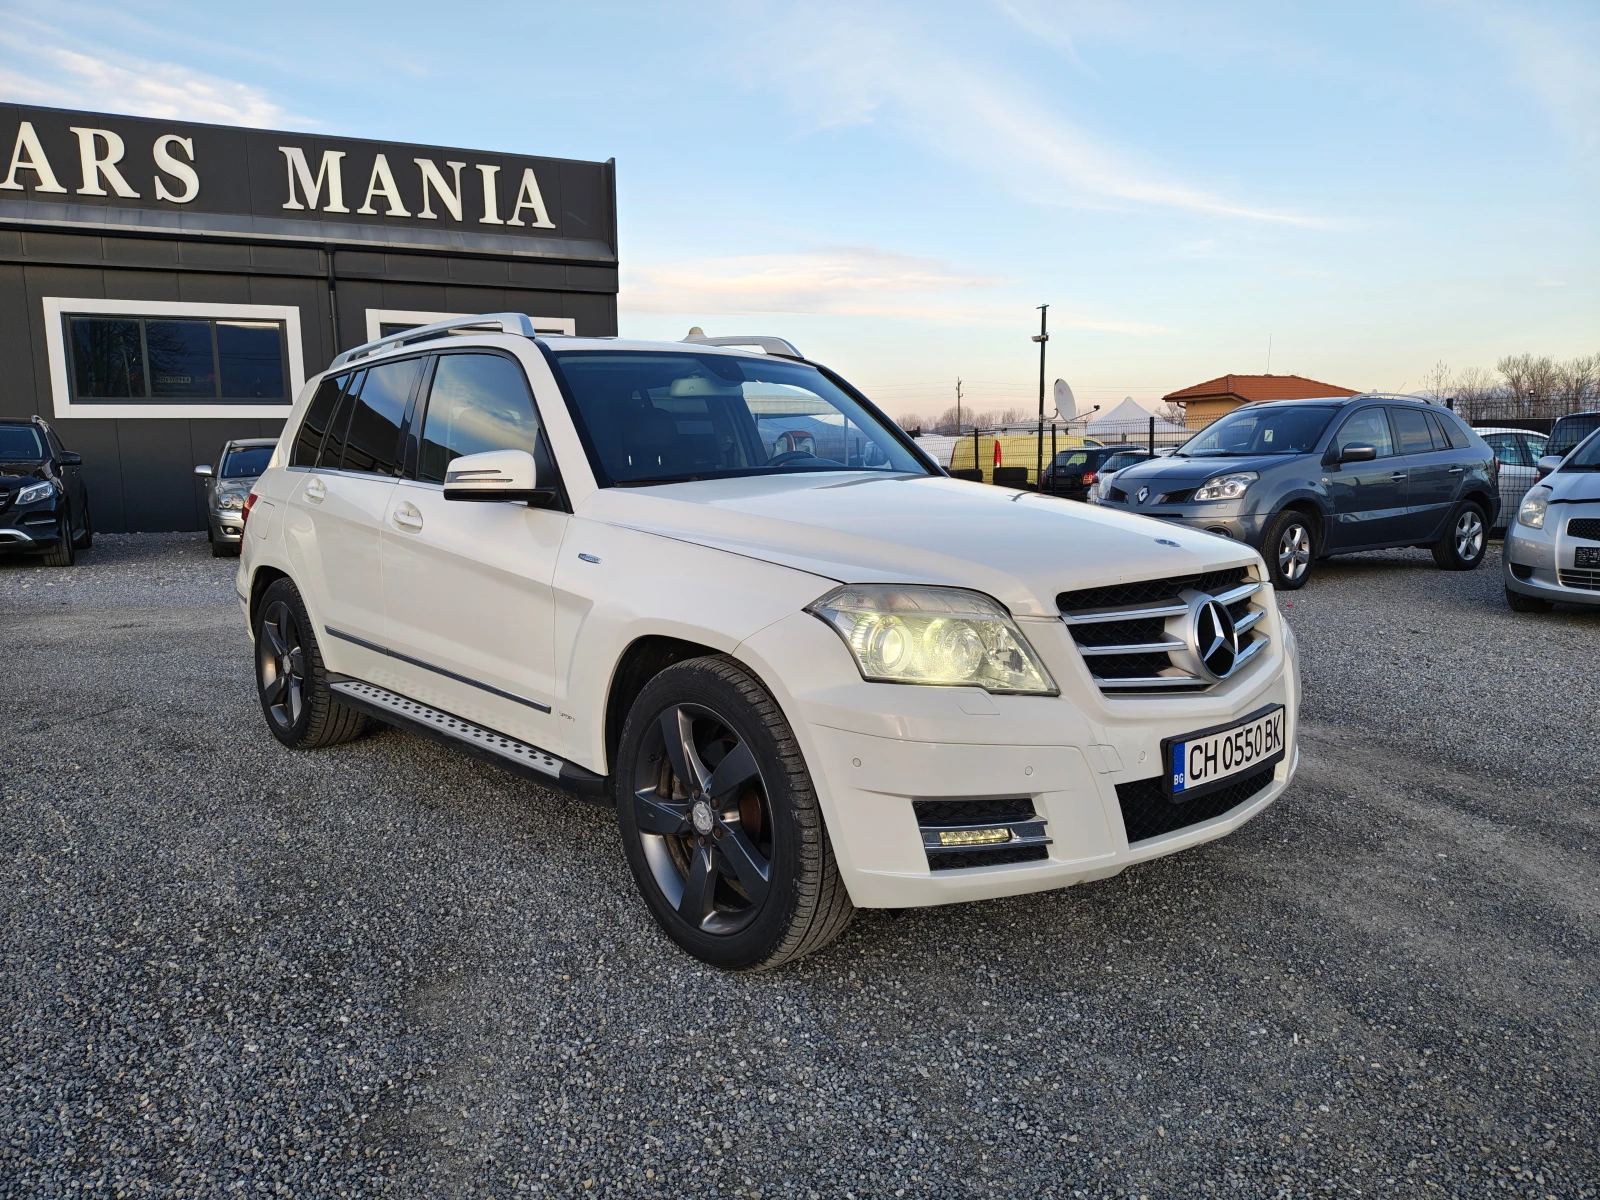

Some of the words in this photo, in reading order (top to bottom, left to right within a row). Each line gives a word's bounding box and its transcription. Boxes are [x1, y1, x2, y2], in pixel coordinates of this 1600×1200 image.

[0, 121, 200, 204] ARS
[278, 146, 556, 230] MANIA
[1173, 773, 1184, 786] BG
[1189, 739, 1218, 781] CH
[1222, 724, 1263, 771] 0550
